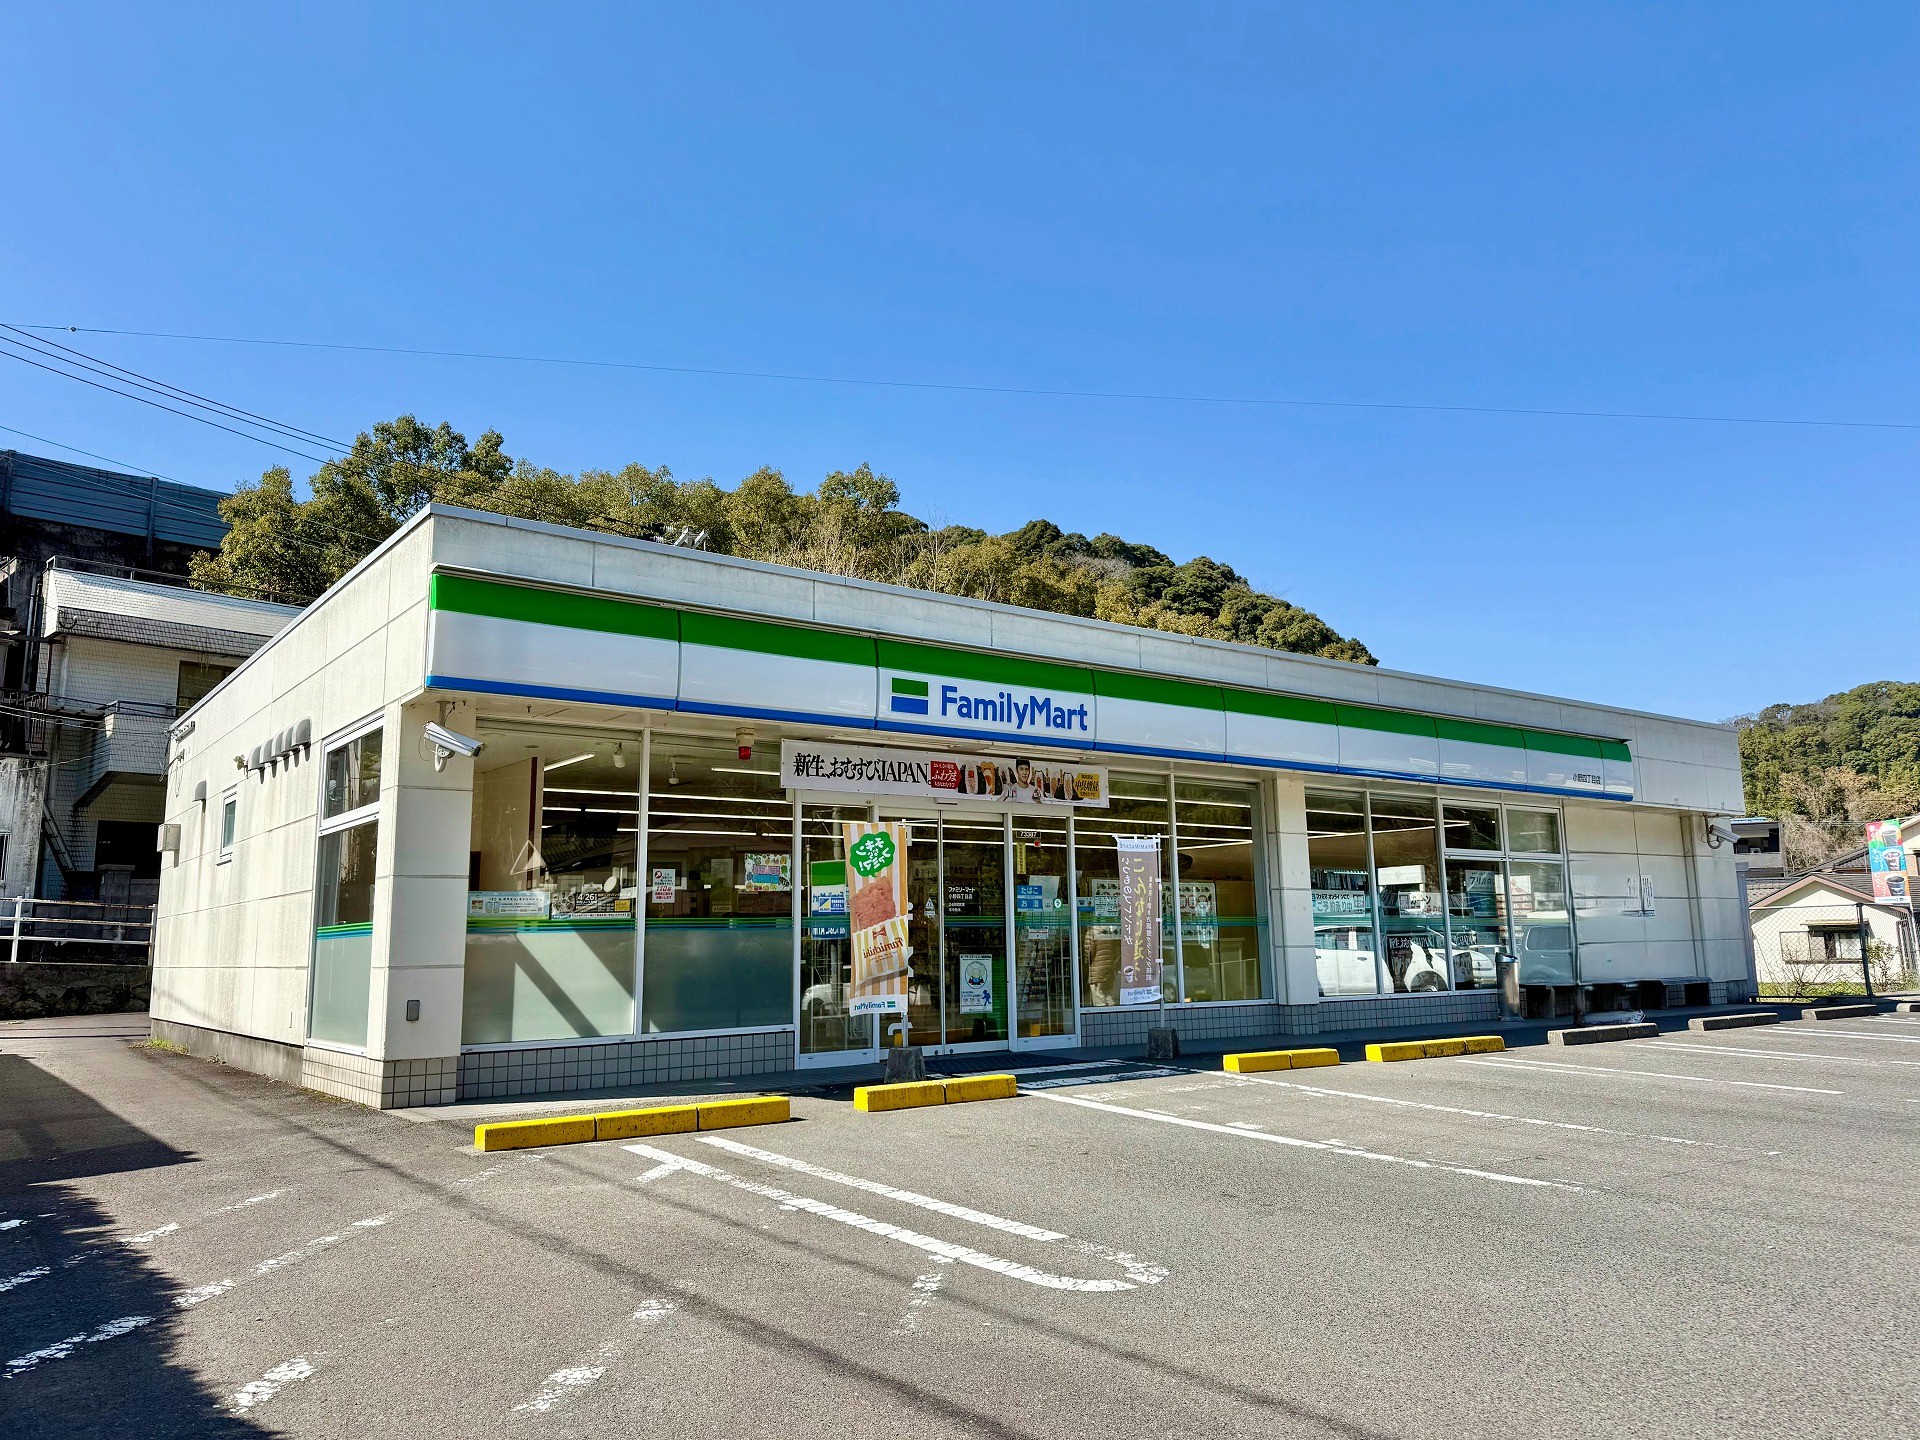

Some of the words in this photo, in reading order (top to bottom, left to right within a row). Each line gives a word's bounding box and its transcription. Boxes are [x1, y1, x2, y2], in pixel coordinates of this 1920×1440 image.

[941, 685, 1088, 731] FamilyMart
[793, 752, 931, 786] 新生、おむすびJAPAN。
[1021, 887, 1039, 895] たばこ
